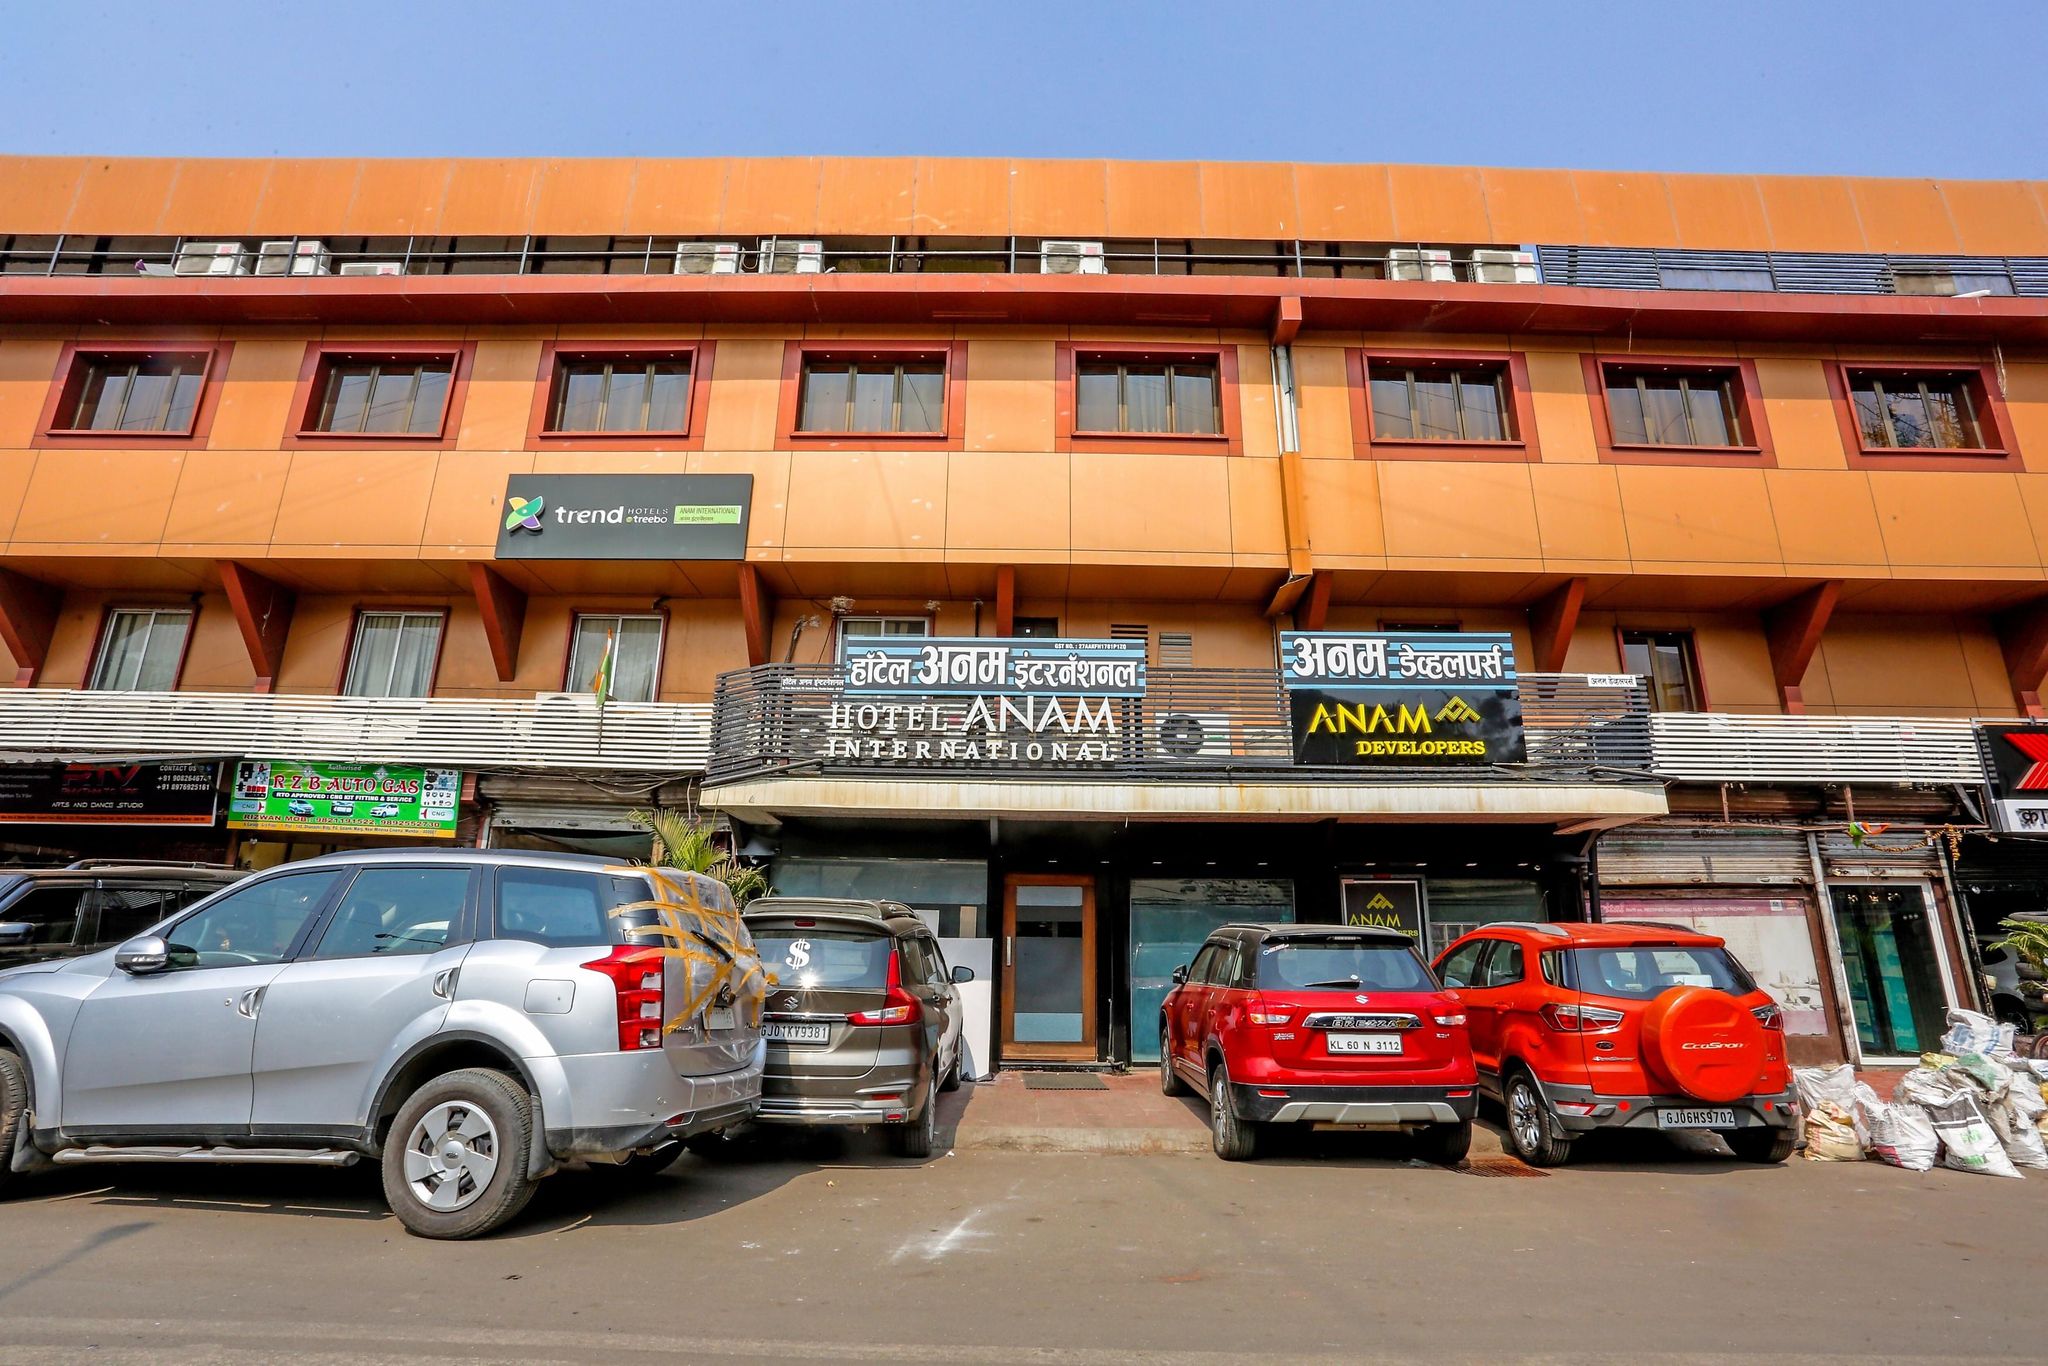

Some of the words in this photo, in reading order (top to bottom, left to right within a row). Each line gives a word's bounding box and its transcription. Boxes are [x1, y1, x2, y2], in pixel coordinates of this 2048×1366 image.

[555, 506, 624, 524] trend
[632, 515, 668, 524] treebo
[1292, 637, 1387, 678] अनम
[1398, 644, 1503, 679] डेव्हलपर्स
[850, 651, 912, 686] हॉटेल
[917, 645, 1009, 685] अनम
[1014, 650, 1138, 690] इंटरनॅशनल
[830, 704, 948, 731] HOTEL
[960, 694, 1116, 734] ANAM
[1308, 702, 1432, 734] ANAM
[829, 738, 1115, 761] INTERNATIONAL
[1356, 740, 1486, 756] DEVELOPERS
[327, 763, 362, 772] Authorised
[273, 775, 285, 789] R
[291, 776, 303, 790] Z
[308, 776, 321, 791] B
[326, 777, 376, 792] AUTO
[382, 779, 419, 794] GAS
[1349, 912, 1401, 927] ANAM
[760, 1025, 826, 1039] GJ01KV9381
[1330, 1041, 1344, 1050] KL
[1347, 1041, 1359, 1050] 60
[1363, 1041, 1370, 1050] N
[1376, 1041, 1400, 1051] 3112
[1666, 1111, 1734, 1125] GJ06HS9702
